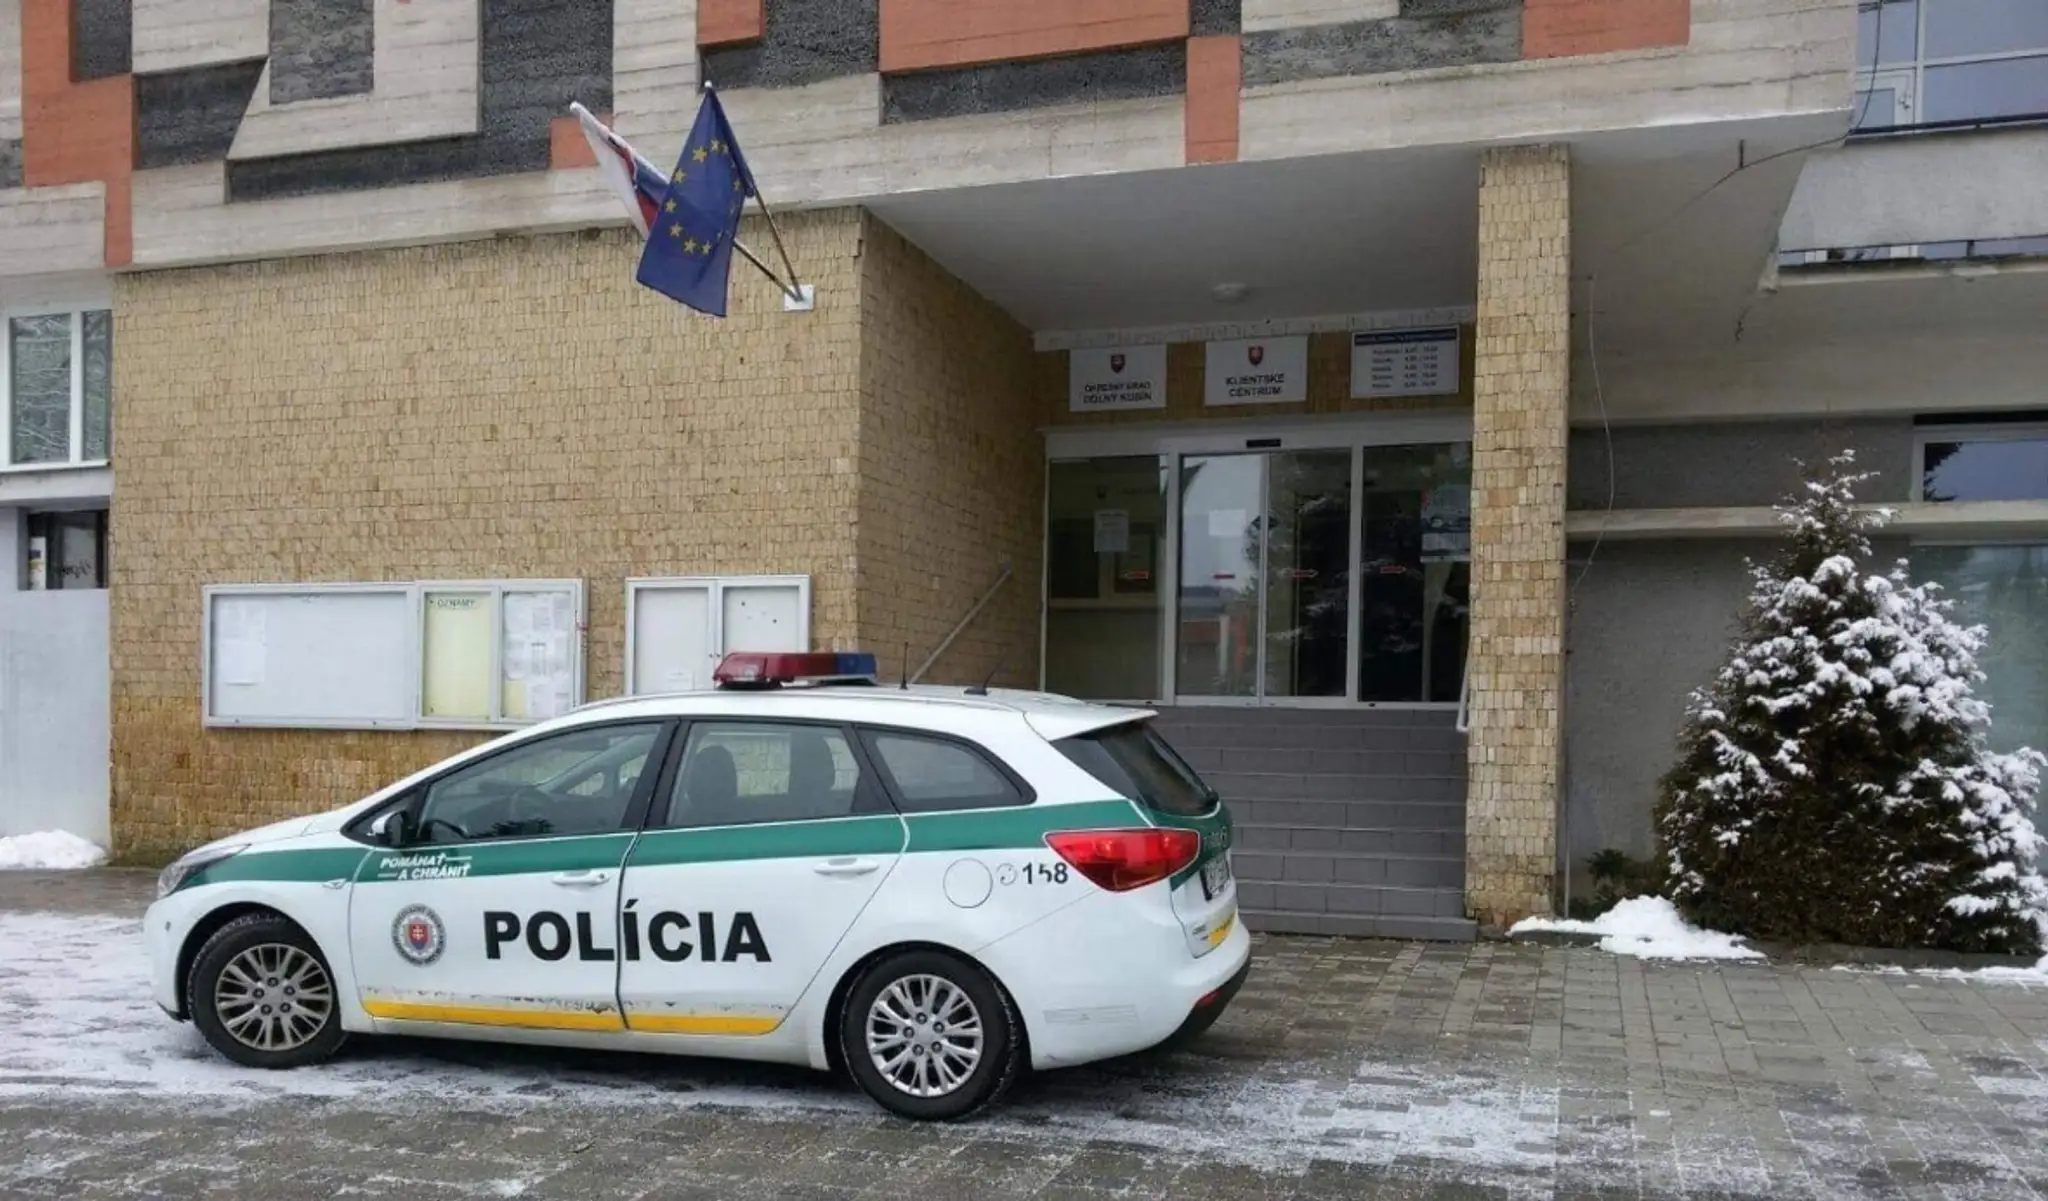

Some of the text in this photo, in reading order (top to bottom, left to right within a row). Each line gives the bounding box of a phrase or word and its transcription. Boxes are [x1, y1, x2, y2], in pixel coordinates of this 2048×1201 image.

[1229, 386, 1281, 397] CENTRUM
[380, 852, 446, 869] POMÁHAŤ
[398, 862, 471, 880] A CHRÁNIŤ
[484, 898, 772, 962] POLÍCIA
